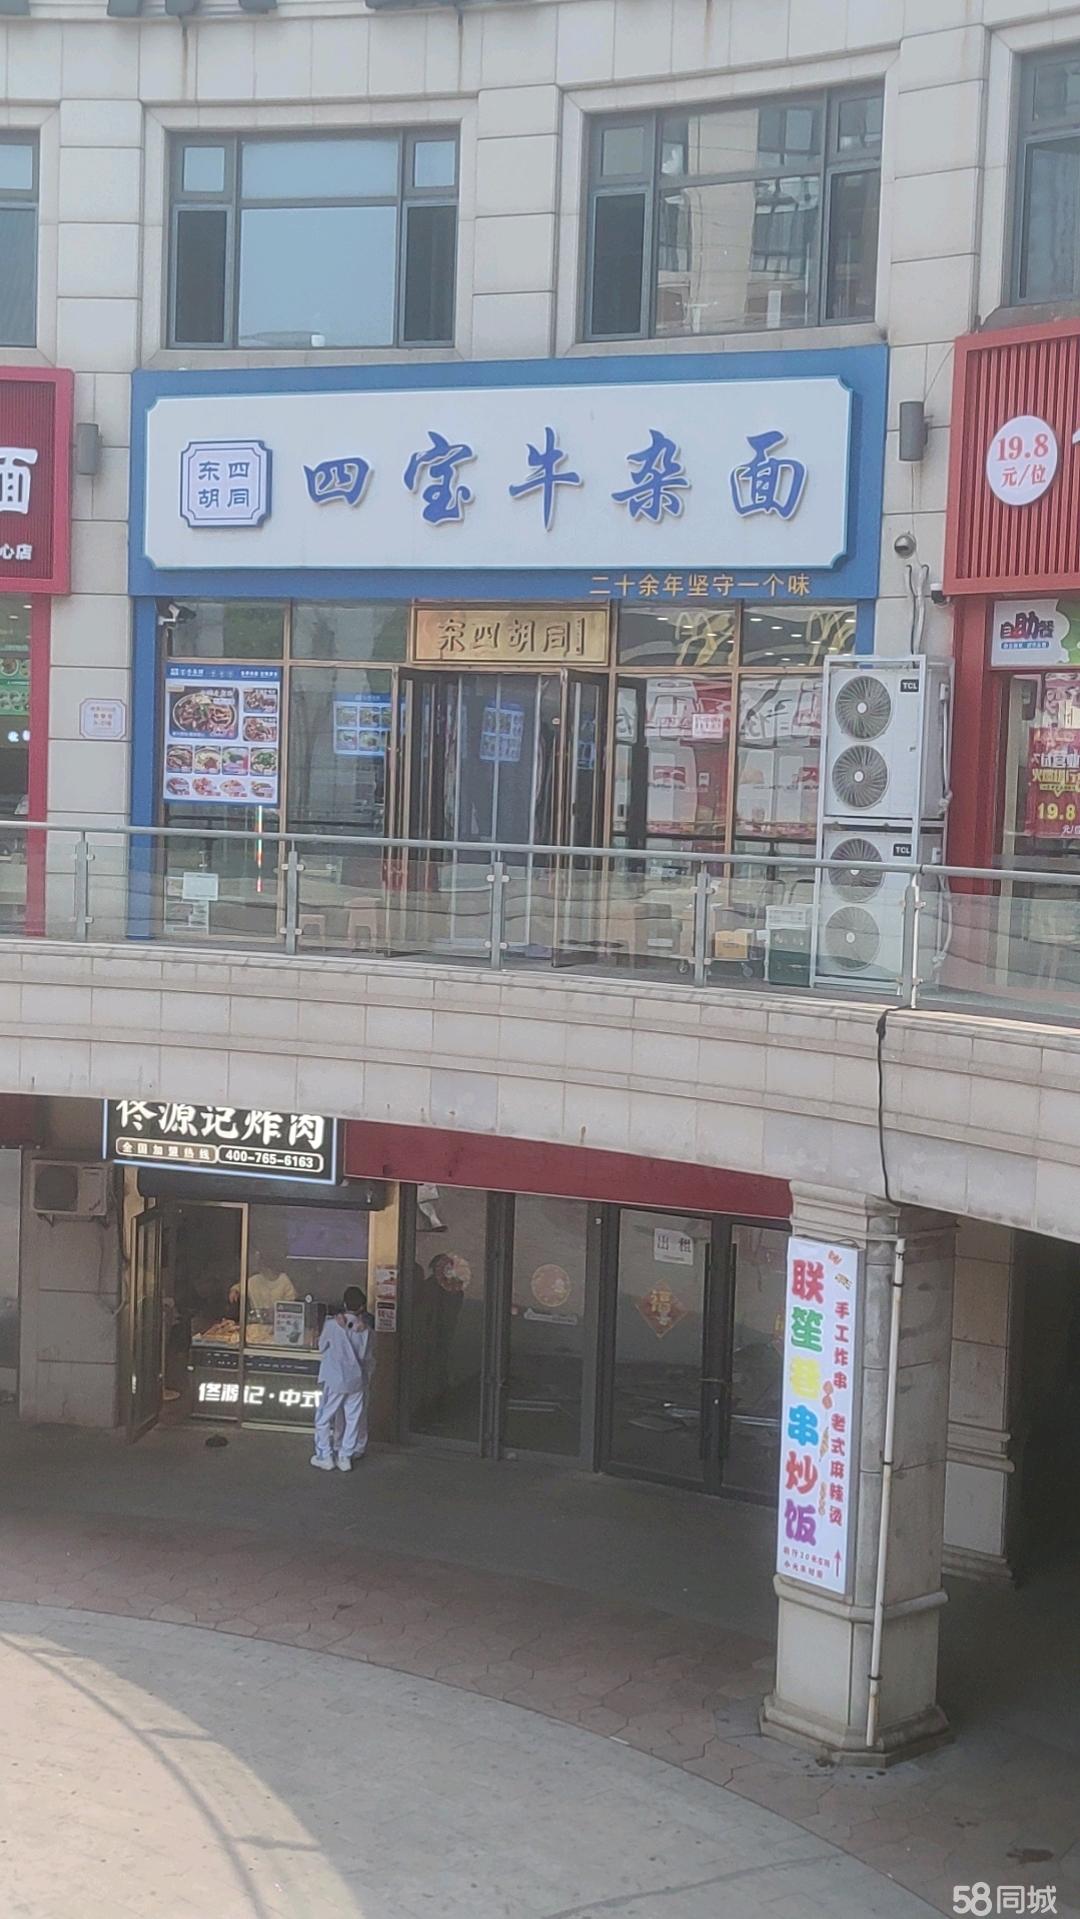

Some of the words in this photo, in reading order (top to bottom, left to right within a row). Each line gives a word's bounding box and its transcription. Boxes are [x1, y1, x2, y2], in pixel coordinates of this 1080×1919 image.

[997, 433, 1049, 461] 19.8
[198, 460, 250, 482] 东四
[303, 427, 808, 532] 四宝牛杂面
[1001, 464, 1046, 488] 元/位
[198, 488, 251, 509] 胡同
[589, 574, 811, 598] 二十余年坚守一个味
[902, 682, 918, 690] TCL
[1037, 803, 1077, 821] 19.8
[895, 846, 911, 854] TCL
[121, 1141, 211, 1161] 全国加盟热线
[225, 1149, 314, 1169] 400-765-6163
[656, 1234, 692, 1253] 出租
[833, 1301, 851, 1391] 手工炸串
[829, 1413, 847, 1528] 老式麻辣烫
